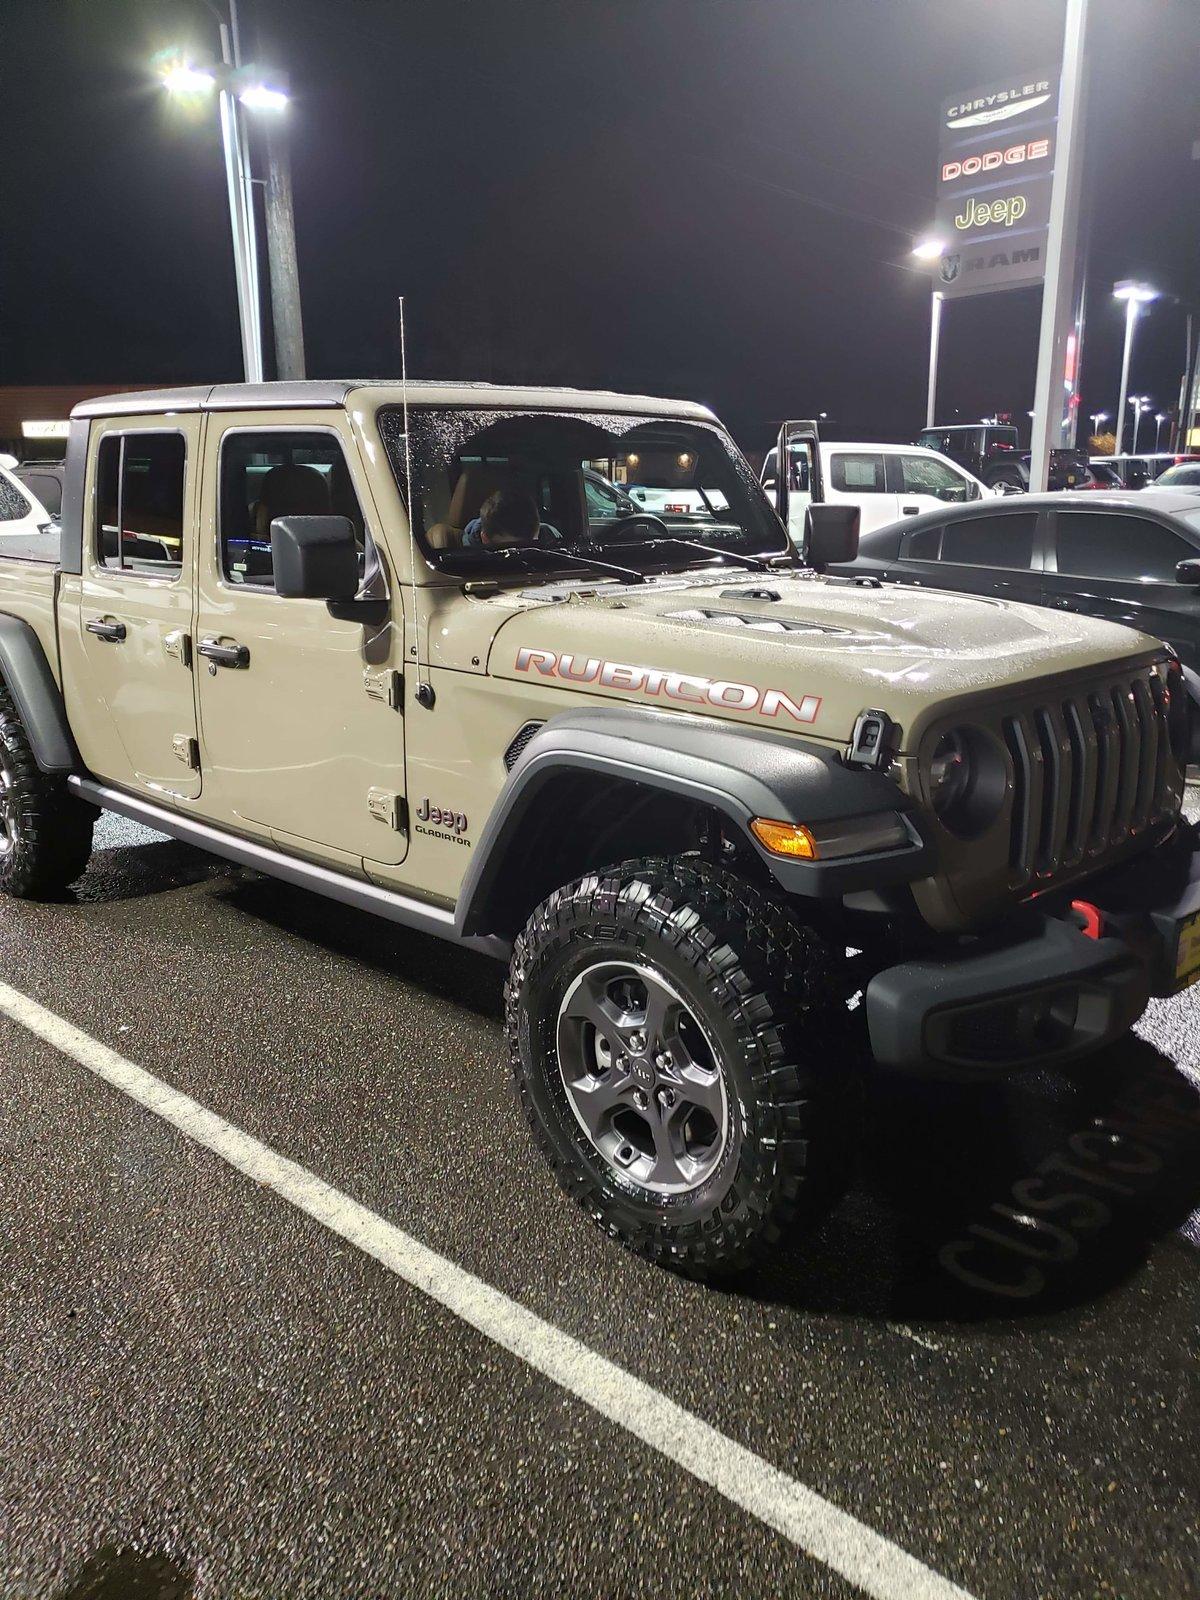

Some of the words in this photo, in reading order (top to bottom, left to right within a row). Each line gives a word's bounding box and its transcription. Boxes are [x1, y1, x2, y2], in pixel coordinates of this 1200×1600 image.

[946, 81, 1050, 118] CHRYSLER
[942, 139, 1049, 181] DODGE
[955, 195, 1027, 230] Jeep
[965, 247, 1040, 272] RAM
[514, 646, 823, 724] RUBICON
[415, 796, 468, 835] Jeep
[415, 825, 471, 848] GLADIATOR
